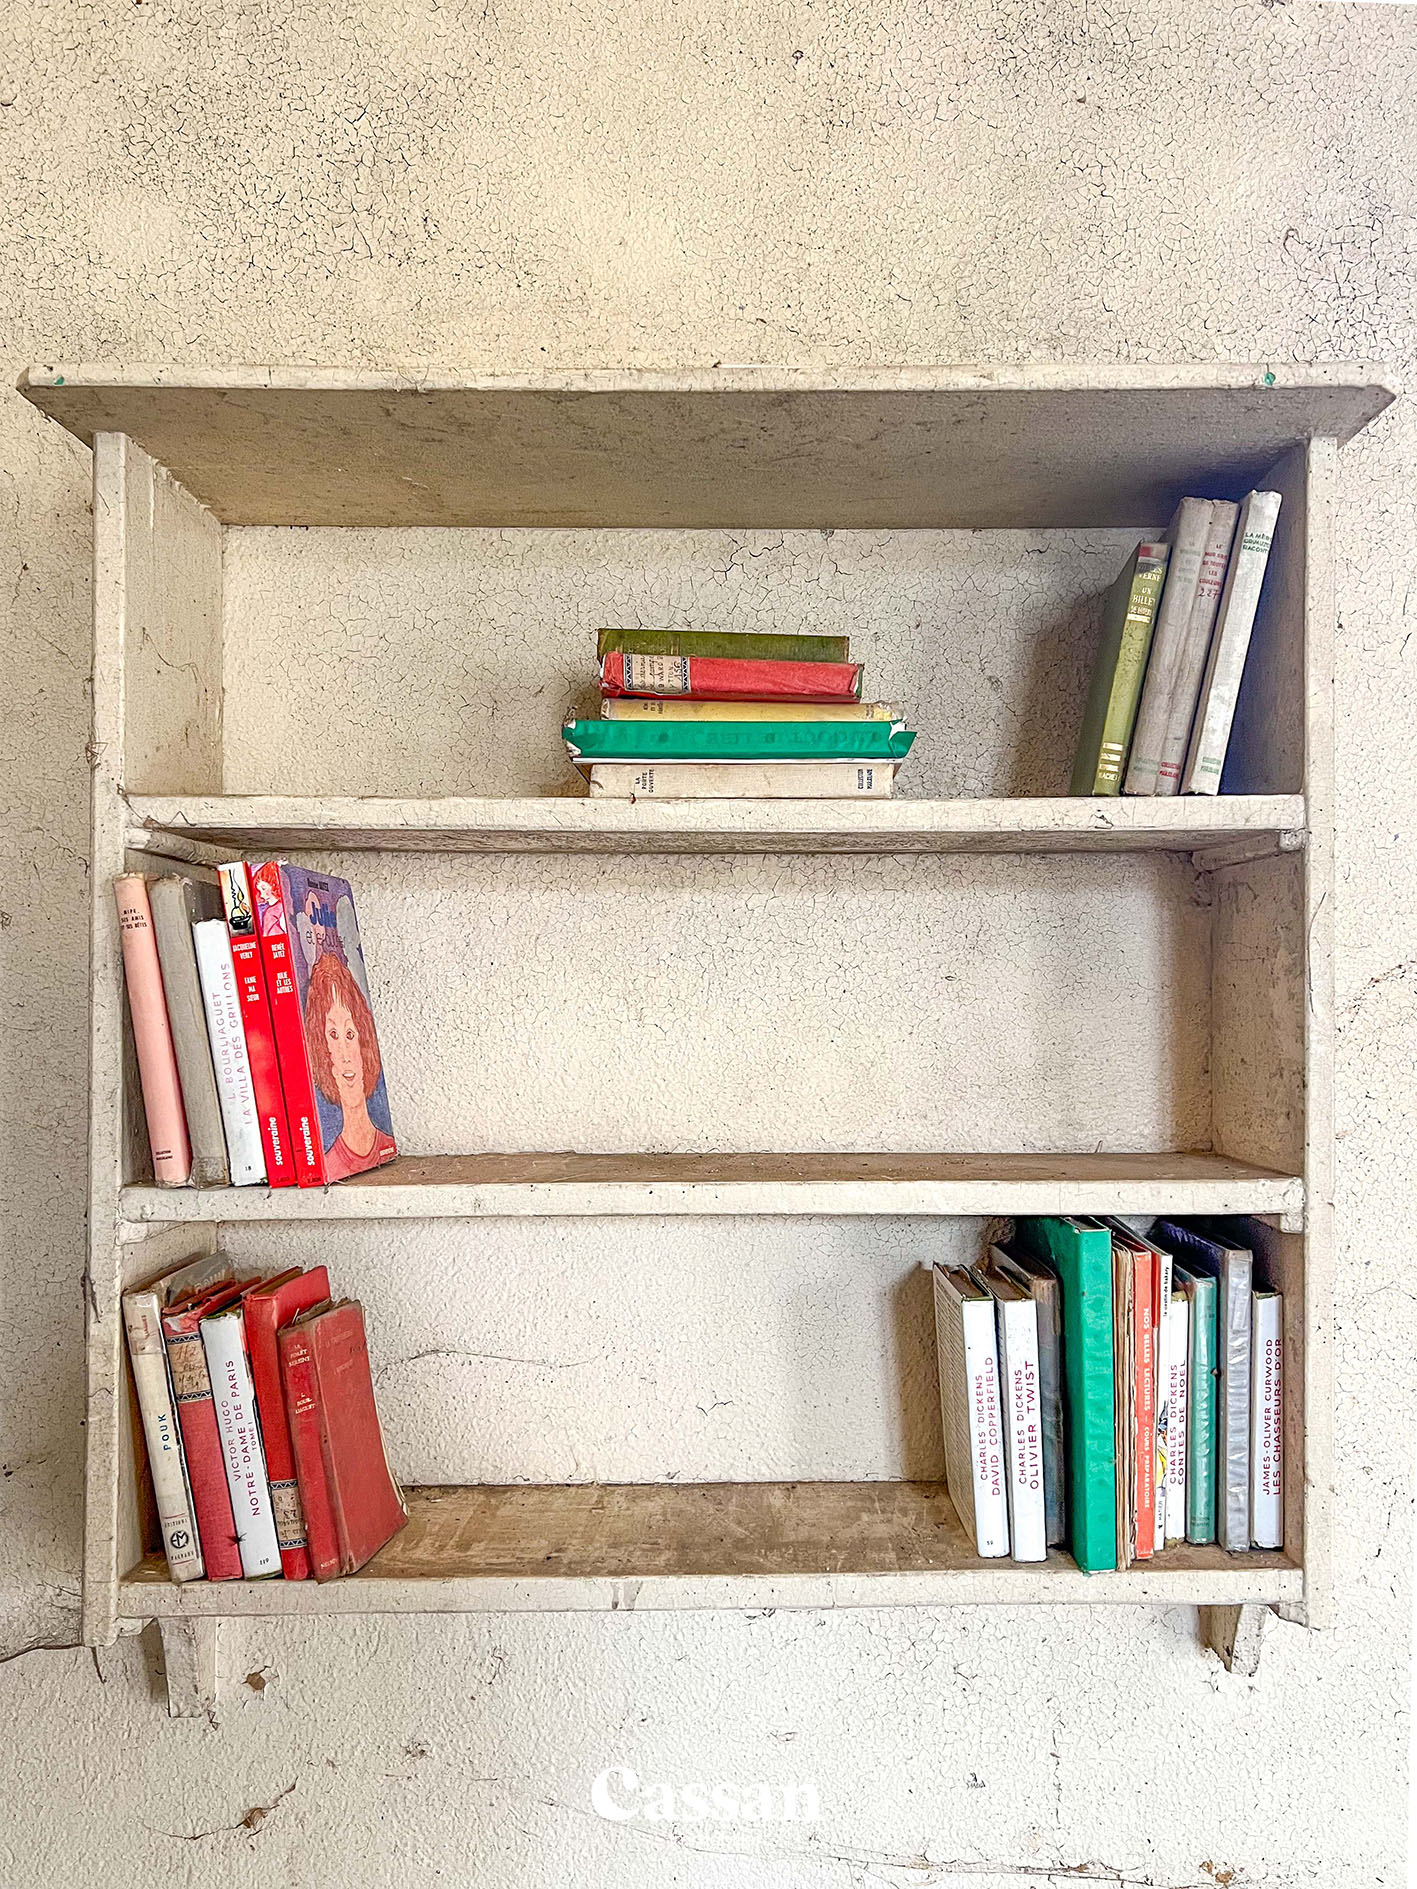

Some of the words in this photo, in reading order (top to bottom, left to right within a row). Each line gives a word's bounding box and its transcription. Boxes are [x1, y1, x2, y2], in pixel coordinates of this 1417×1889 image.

[635, 776, 641, 785] LA
[212, 992, 234, 1084] BOURLIAGUET
[232, 1035, 243, 1059] DES
[237, 1065, 249, 1103] VILLA
[267, 1116, 284, 1166] souveraine
[299, 1116, 316, 1166] souveraine
[1143, 1333, 1151, 1364] BELLES
[1264, 1339, 1273, 1402] CURWOOD
[1274, 1338, 1282, 1371] D'OR
[225, 1360, 240, 1398] PARIS
[975, 1374, 985, 1423] DICKENS
[985, 1357, 998, 1446] COPPERFIELD
[1014, 1369, 1025, 1422] DICKENS
[1024, 1360, 1036, 1414] TWIST
[1143, 1368, 1151, 1412] LECTURES
[1169, 1364, 1178, 1418] DICKENS
[157, 1414, 172, 1451] POUK
[220, 1400, 234, 1434] HUGO
[233, 1403, 244, 1421] DE
[1178, 1407, 1185, 1423] DE
[1272, 1379, 1282, 1463] CHASSEURS
[227, 1438, 241, 1482] VICTOR
[248, 1428, 257, 1451] TOME
[978, 1431, 988, 1481] CHARLES
[1017, 1429, 1028, 1485] CHARLES
[1027, 1424, 1040, 1490] OLIVIER
[1169, 1426, 1177, 1484] CHARLES
[1177, 1430, 1185, 1486] CONTES
[237, 1426, 261, 1516] NOTRE-DAME
[990, 1454, 1001, 1496] DAVID
[1271, 1470, 1281, 1495] LES
